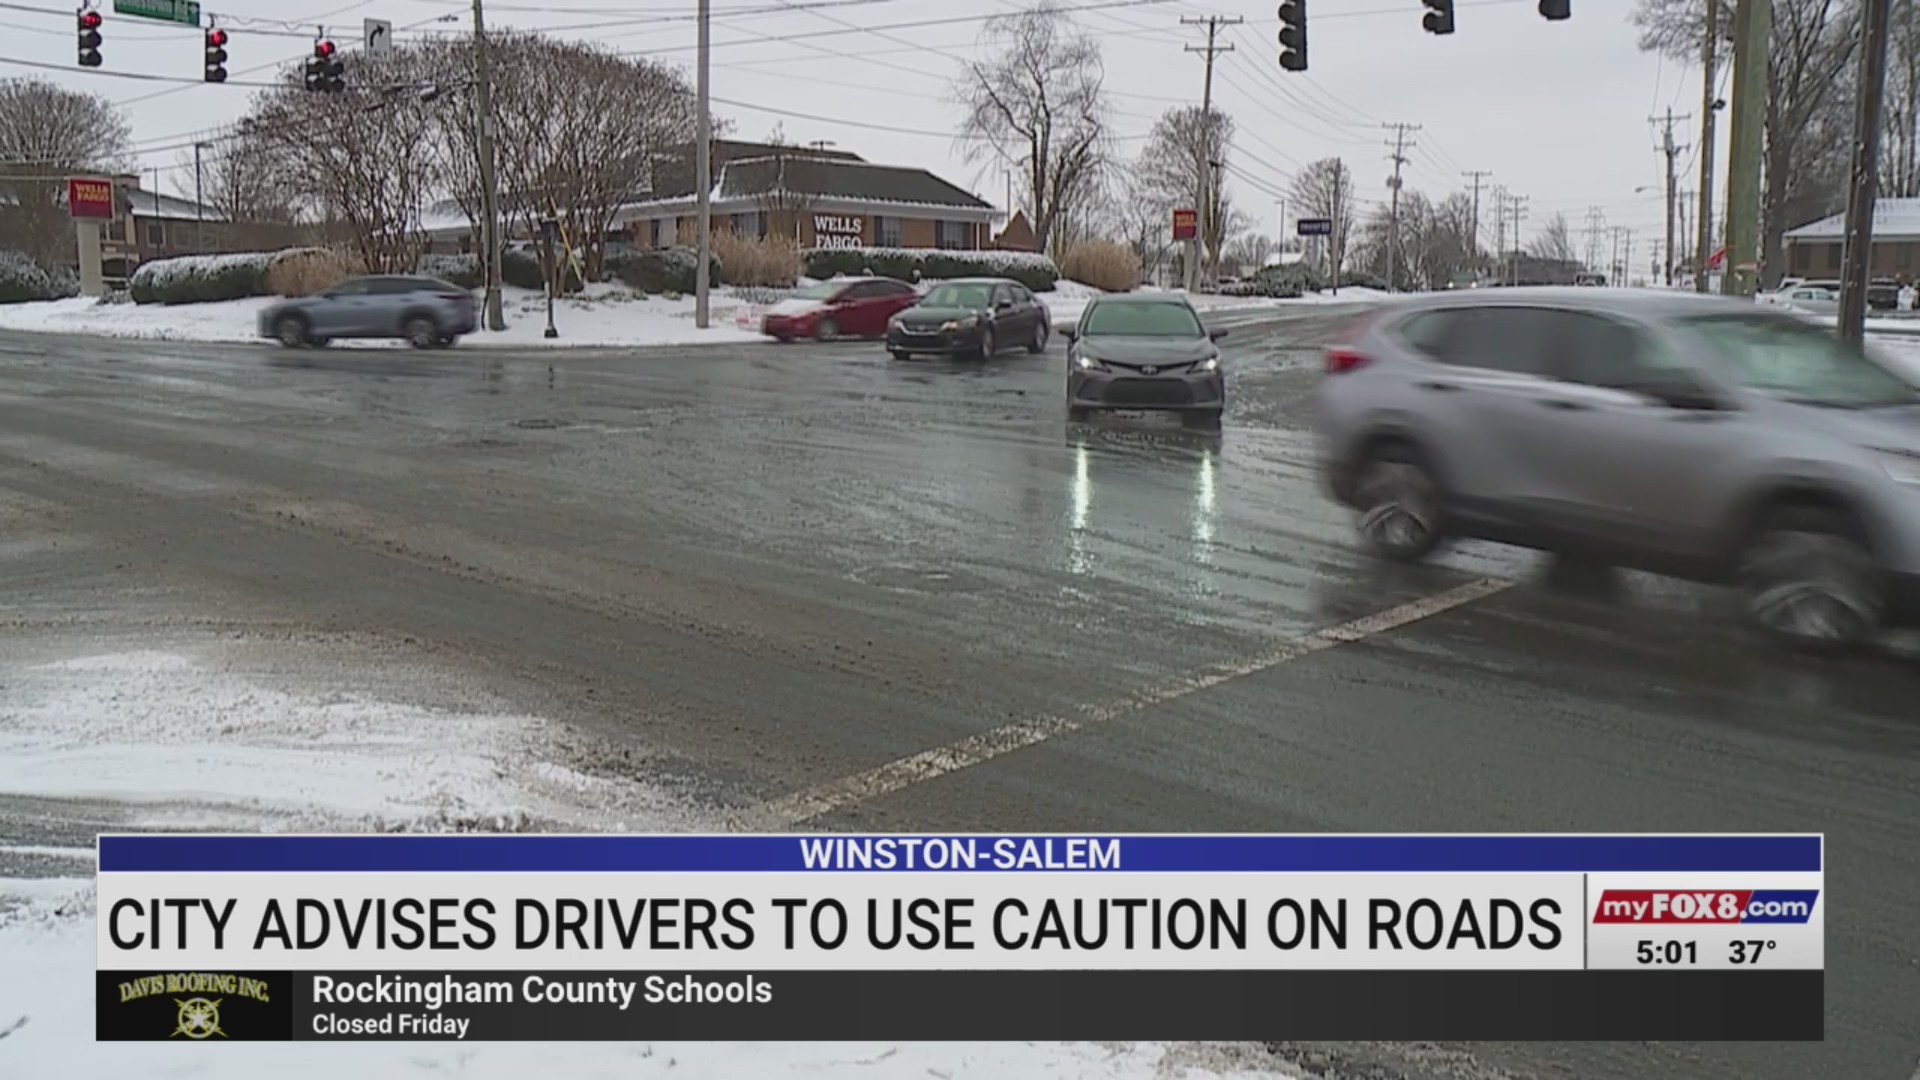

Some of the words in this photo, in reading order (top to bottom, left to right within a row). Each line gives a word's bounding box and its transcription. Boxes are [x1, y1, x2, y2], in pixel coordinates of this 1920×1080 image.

[75, 183, 108, 192] WELLS
[77, 191, 109, 202] FARGO
[814, 215, 862, 234] WELLS
[815, 234, 862, 250] FARGO
